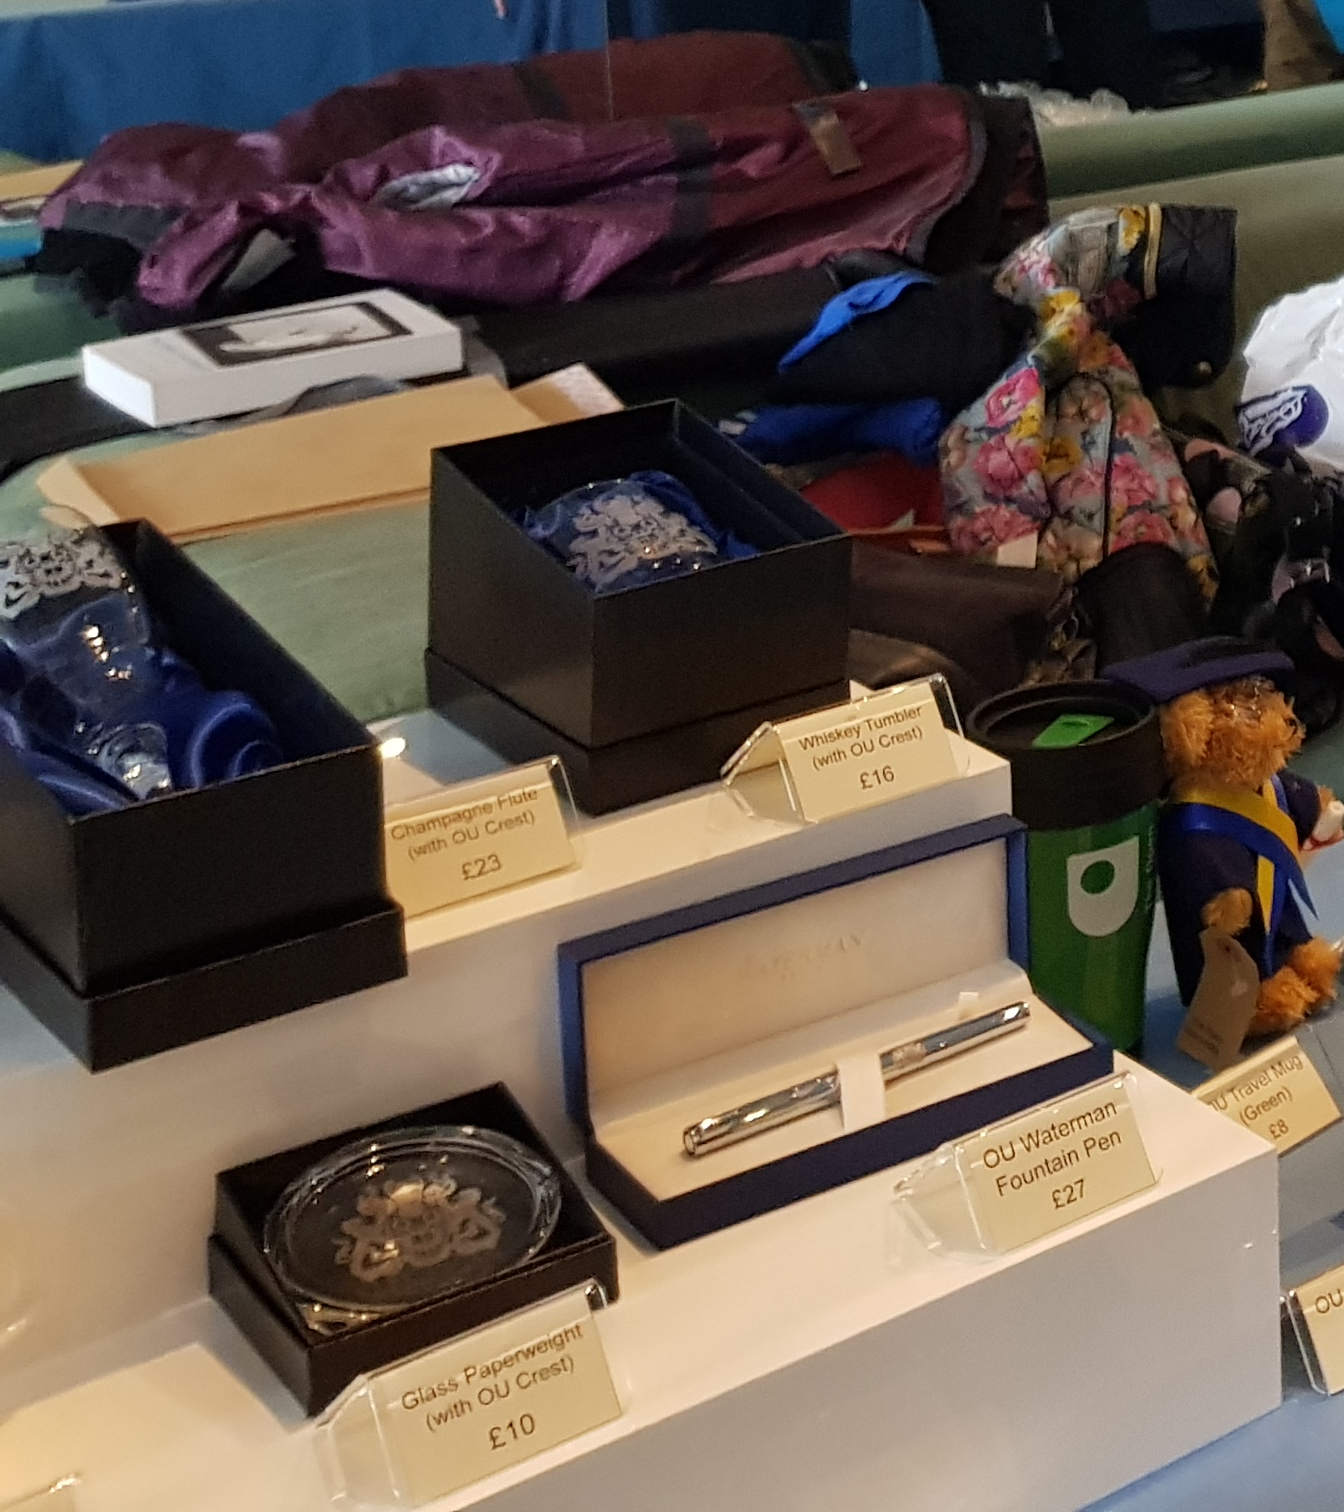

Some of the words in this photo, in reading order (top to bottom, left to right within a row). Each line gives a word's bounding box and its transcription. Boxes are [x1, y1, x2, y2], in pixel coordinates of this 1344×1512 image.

[798, 724, 861, 753] Whiskey
[864, 705, 923, 732] Tumbler
[811, 746, 847, 772] (with
[850, 740, 875, 758] OU
[878, 726, 924, 749] Crest)
[859, 765, 895, 790] £16
[390, 801, 494, 842] Champagne
[497, 789, 538, 810] Flute
[407, 836, 448, 862] (with
[452, 827, 480, 844] OU
[484, 810, 536, 836] Crest)
[461, 854, 503, 880] £23
[1230, 1072, 1272, 1104] Travel
[1271, 1055, 1304, 1079] Mug
[1239, 1086, 1293, 1126] (Green)
[1269, 1118, 1289, 1140] £8
[983, 1144, 1016, 1170] OU
[1019, 1100, 1118, 1154] Waterman
[996, 1148, 1080, 1197] Fountain
[1083, 1130, 1122, 1159] Pen
[1051, 1178, 1087, 1210] £27
[1315, 1289, 1344, 1315] OU
[401, 1375, 460, 1411] Glass
[463, 1323, 585, 1385] Paperweight
[426, 1399, 473, 1433] (with
[477, 1380, 511, 1406] OU
[516, 1355, 575, 1391] Crest)
[488, 1413, 536, 1452] £10
